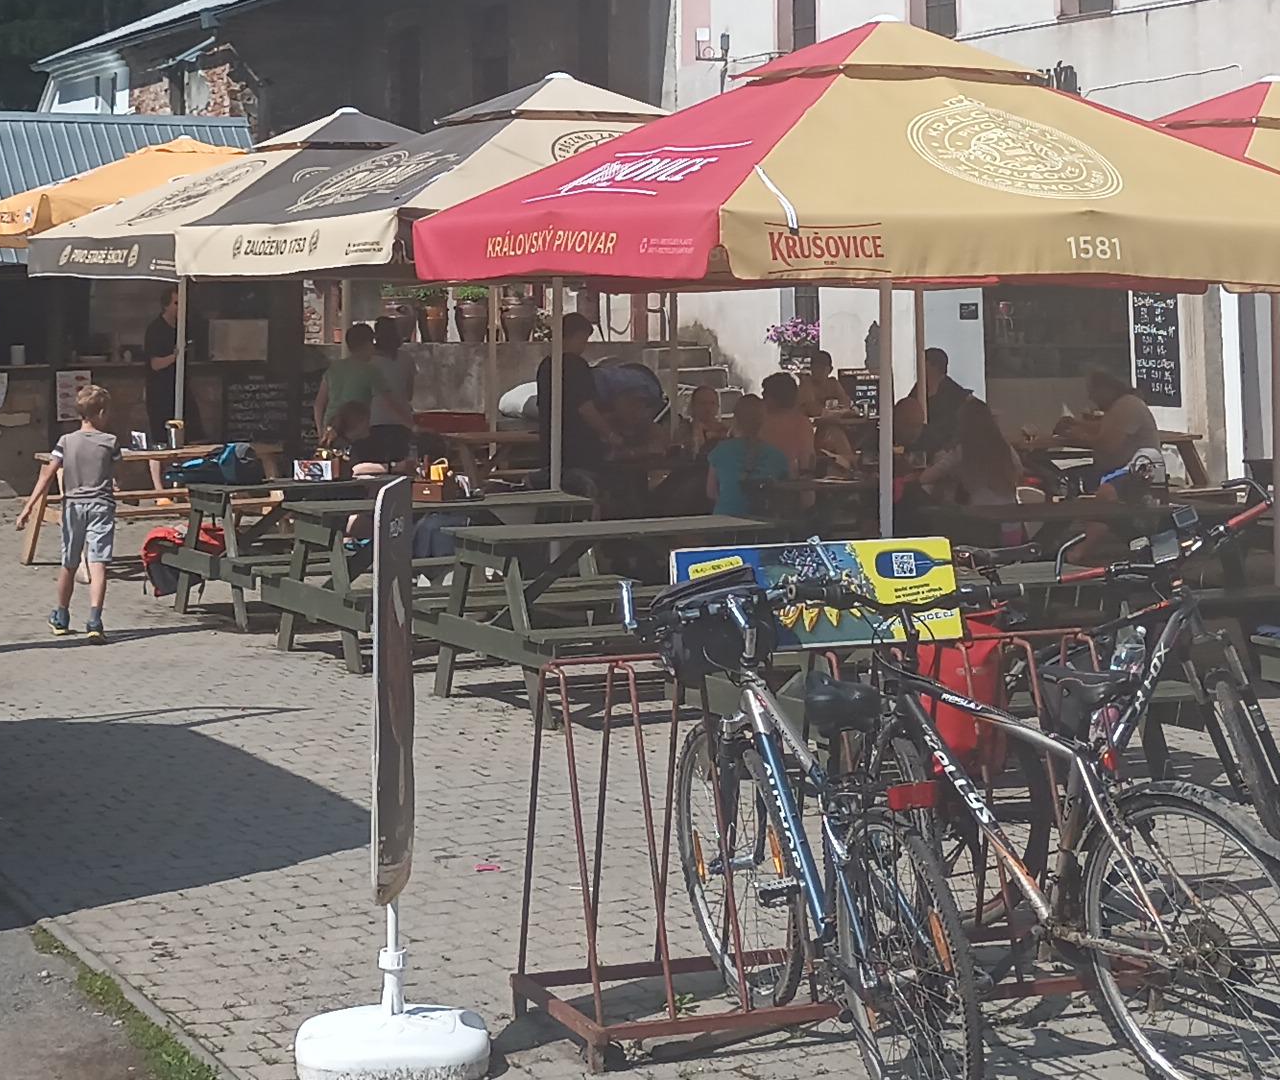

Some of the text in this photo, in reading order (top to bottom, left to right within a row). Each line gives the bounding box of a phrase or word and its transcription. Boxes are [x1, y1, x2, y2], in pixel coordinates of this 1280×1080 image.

[243, 236, 288, 256] ZALOŽENO
[486, 225, 554, 258] KRÁLOVSKÝ
[553, 231, 617, 255] PIVOVAR
[768, 231, 885, 267] KRUŠOVICE
[1066, 235, 1121, 260] 1581
